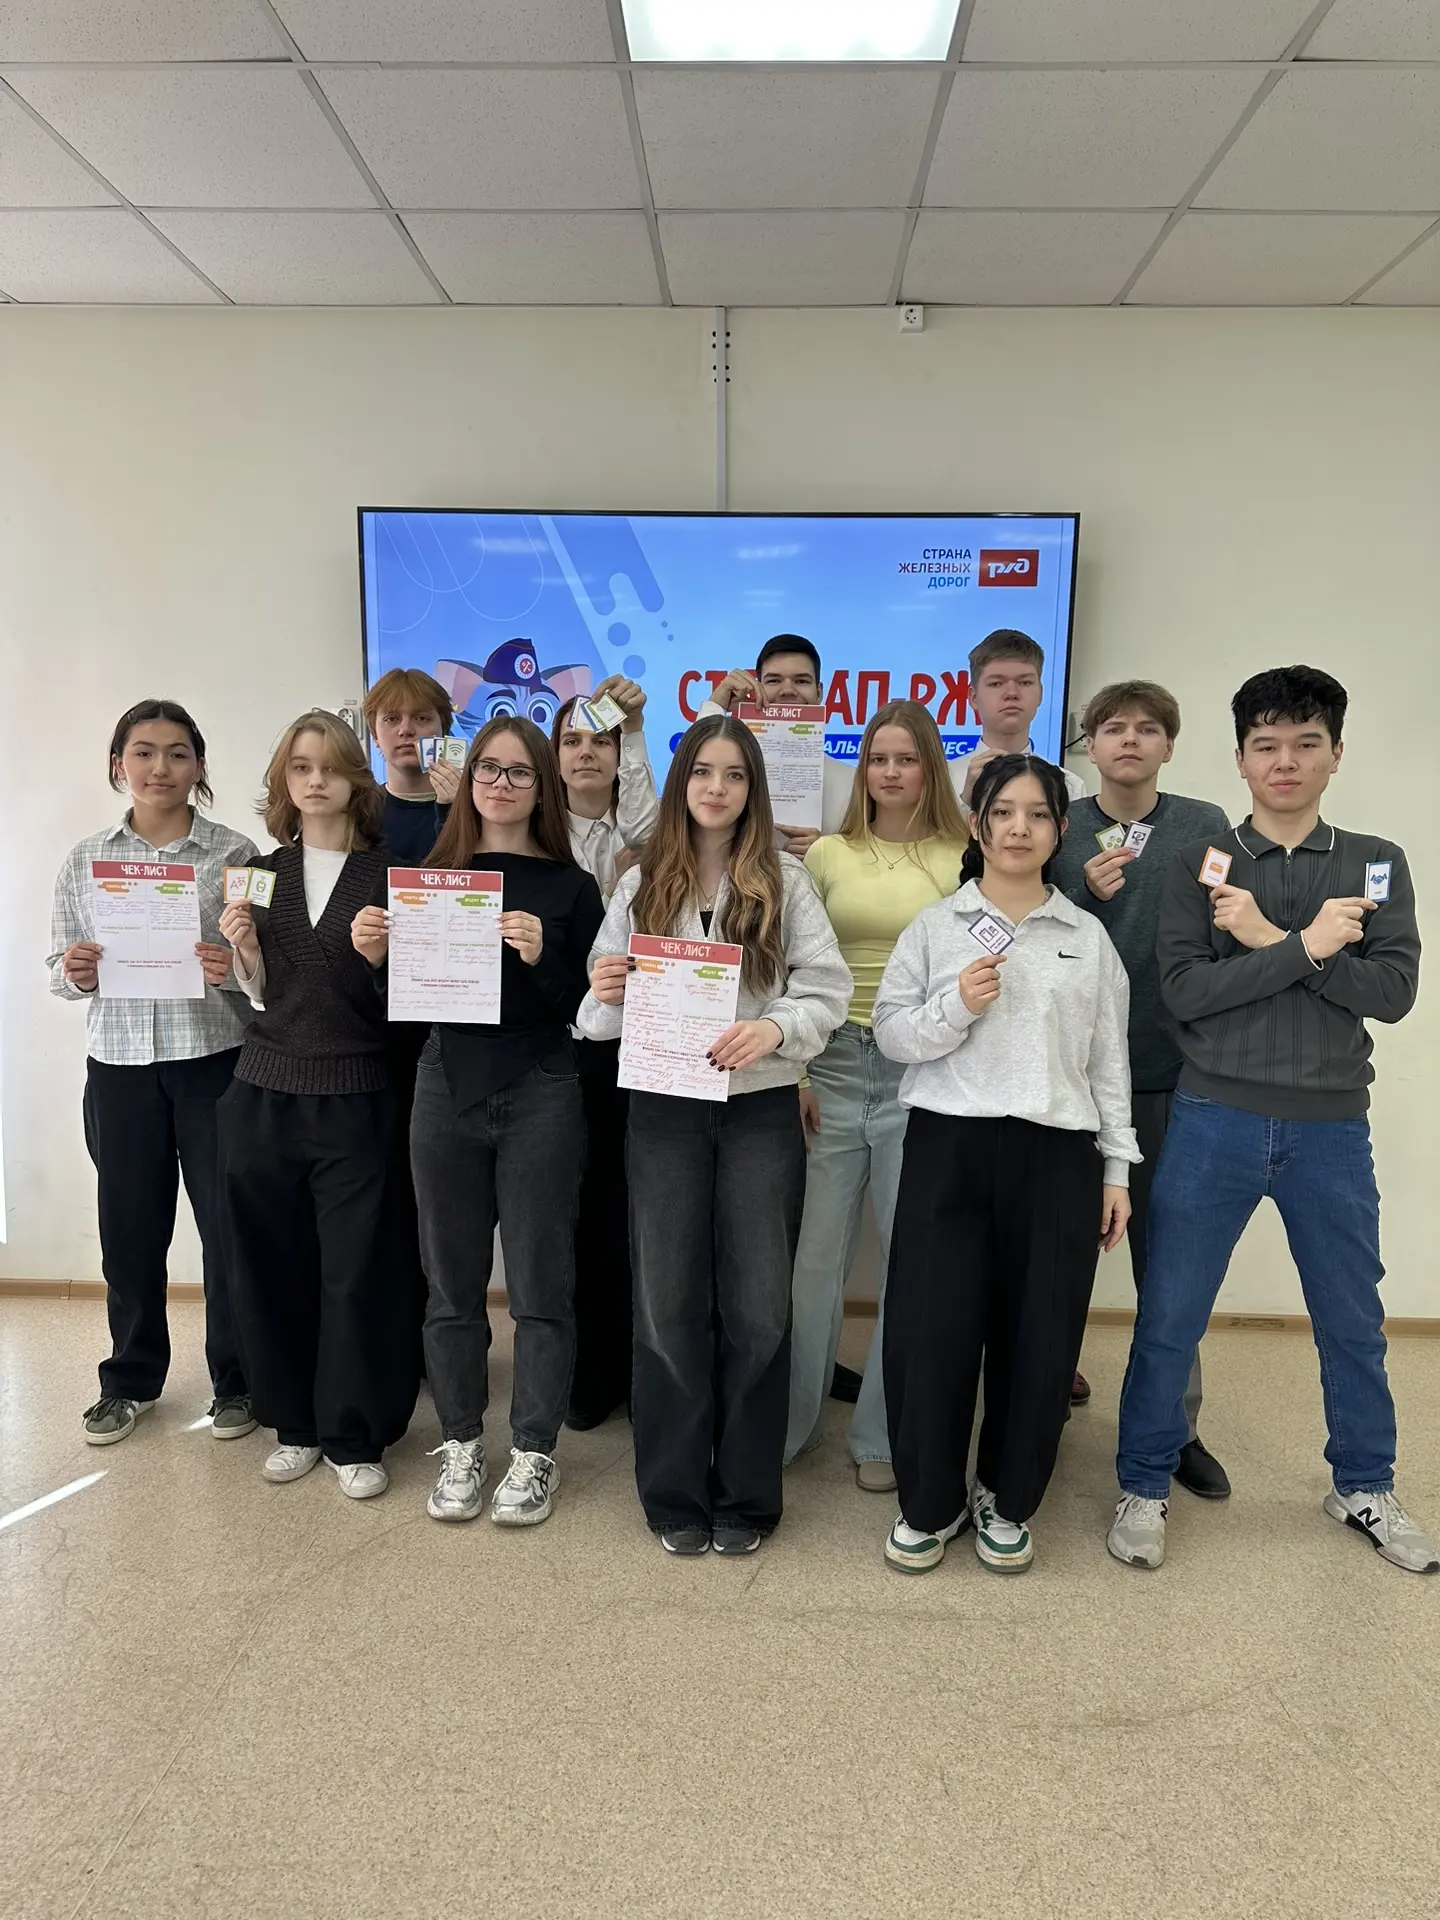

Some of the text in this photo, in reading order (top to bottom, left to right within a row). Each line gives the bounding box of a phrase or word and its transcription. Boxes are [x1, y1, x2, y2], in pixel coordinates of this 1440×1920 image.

[923, 549, 972, 560] СТРАНА
[899, 563, 971, 573] ЖЕЛЕЗНЫХ
[928, 577, 971, 589] ДОРОГ
[762, 707, 802, 718] ЧЕК-ЛИСТ
[121, 864, 167, 876] ЧЕК-ЛИСТ
[420, 873, 472, 886] ЧЕК-ЛИСТ
[660, 941, 711, 957] ЧЕК-ЛИСТ
